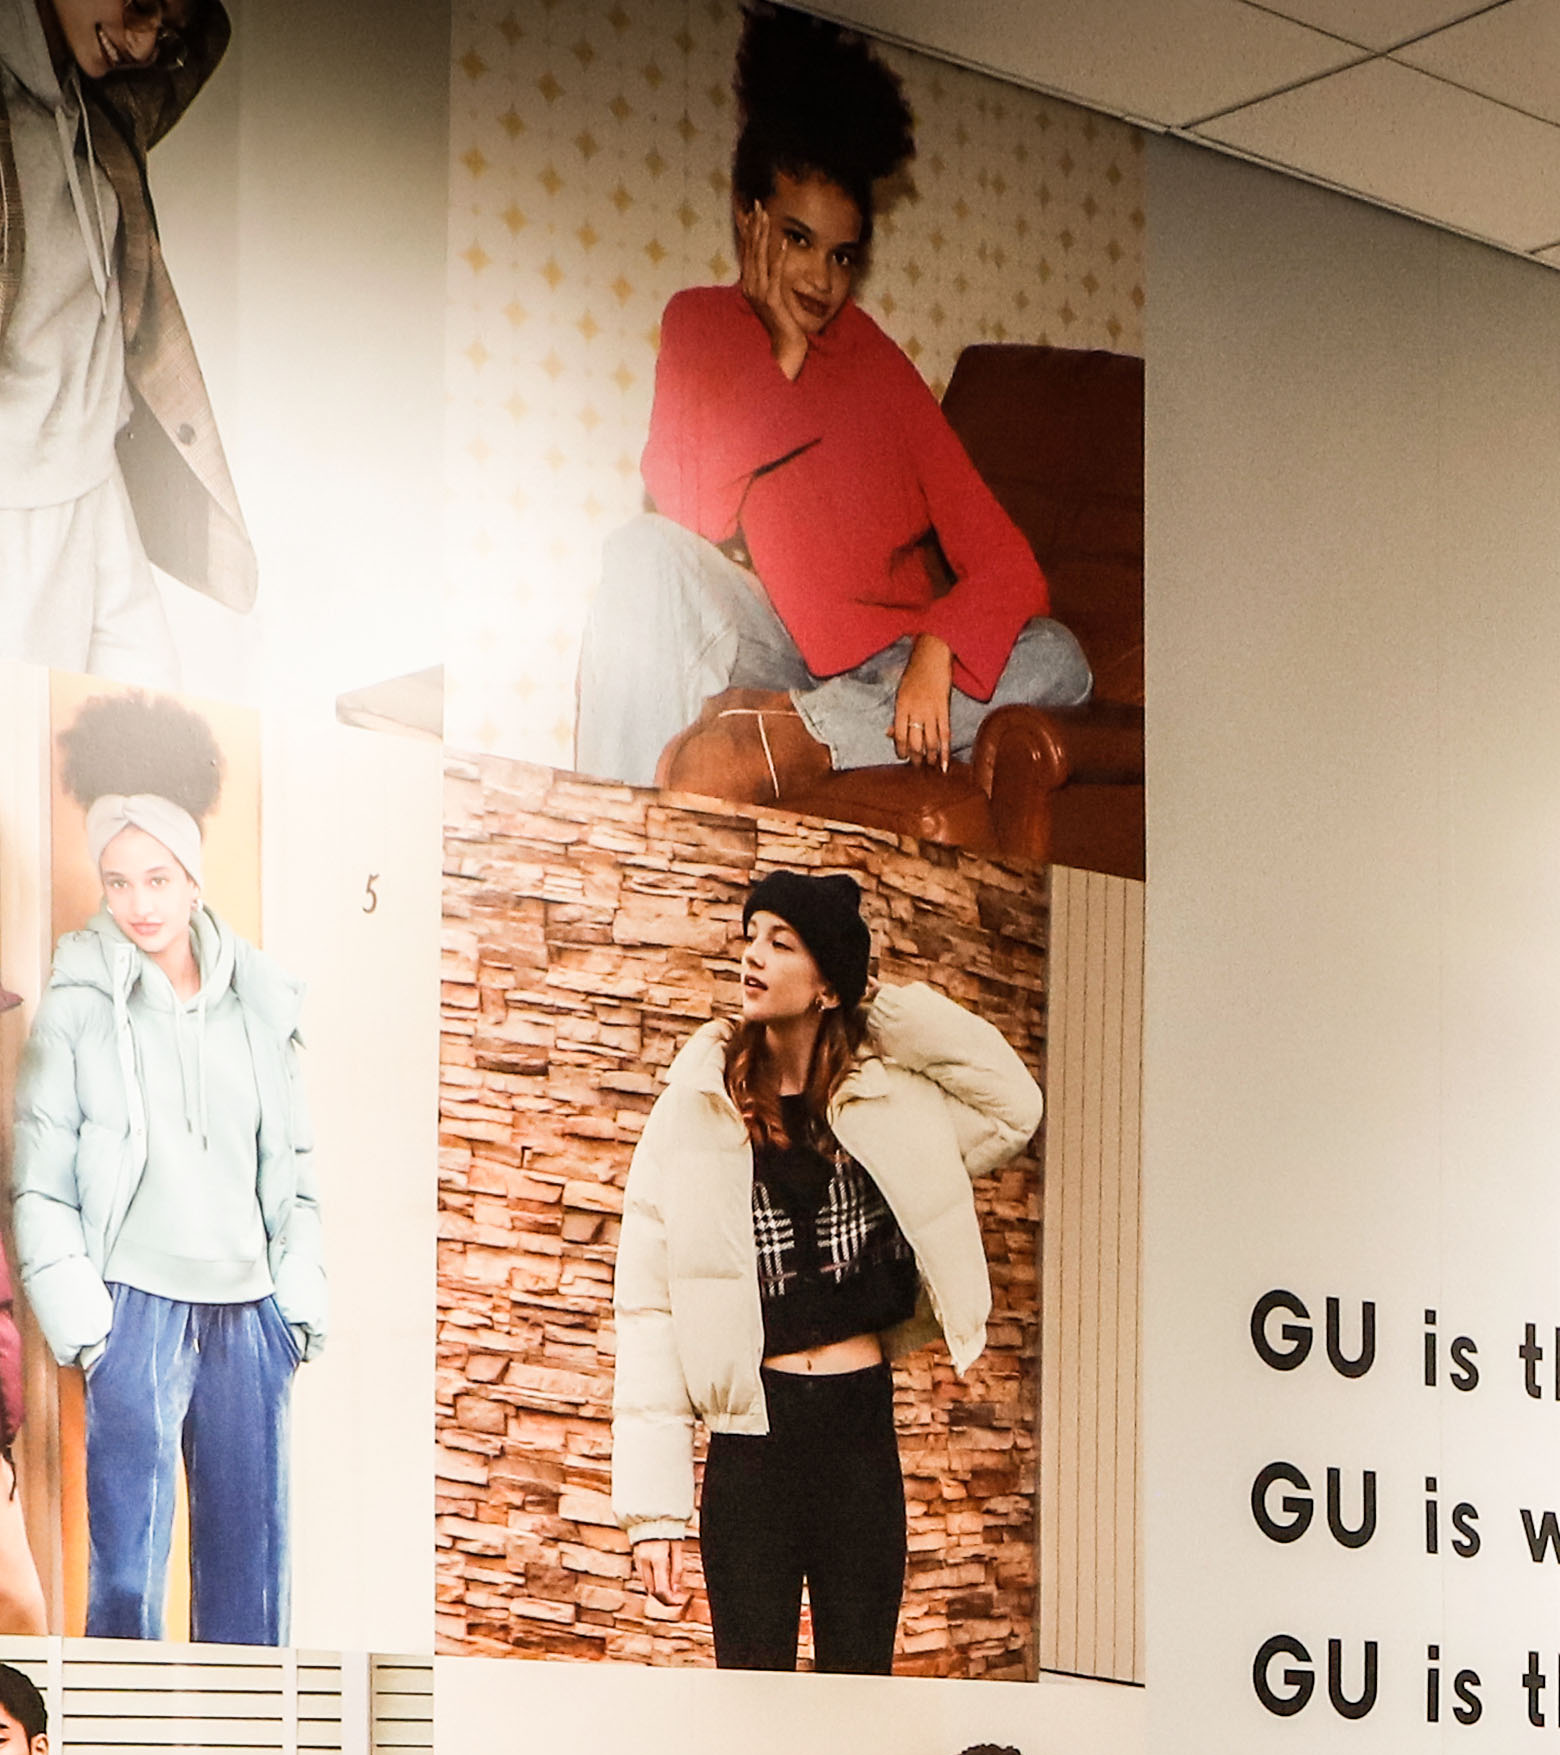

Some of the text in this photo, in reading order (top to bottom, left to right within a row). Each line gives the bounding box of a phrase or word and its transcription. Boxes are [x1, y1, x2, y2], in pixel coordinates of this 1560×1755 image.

[362, 873, 380, 914] 5
[1250, 1288, 1560, 1402] GU is t
[1250, 1461, 1377, 1549] GU
[1425, 1476, 1481, 1559] is
[1252, 1634, 1560, 1729] GU is t
